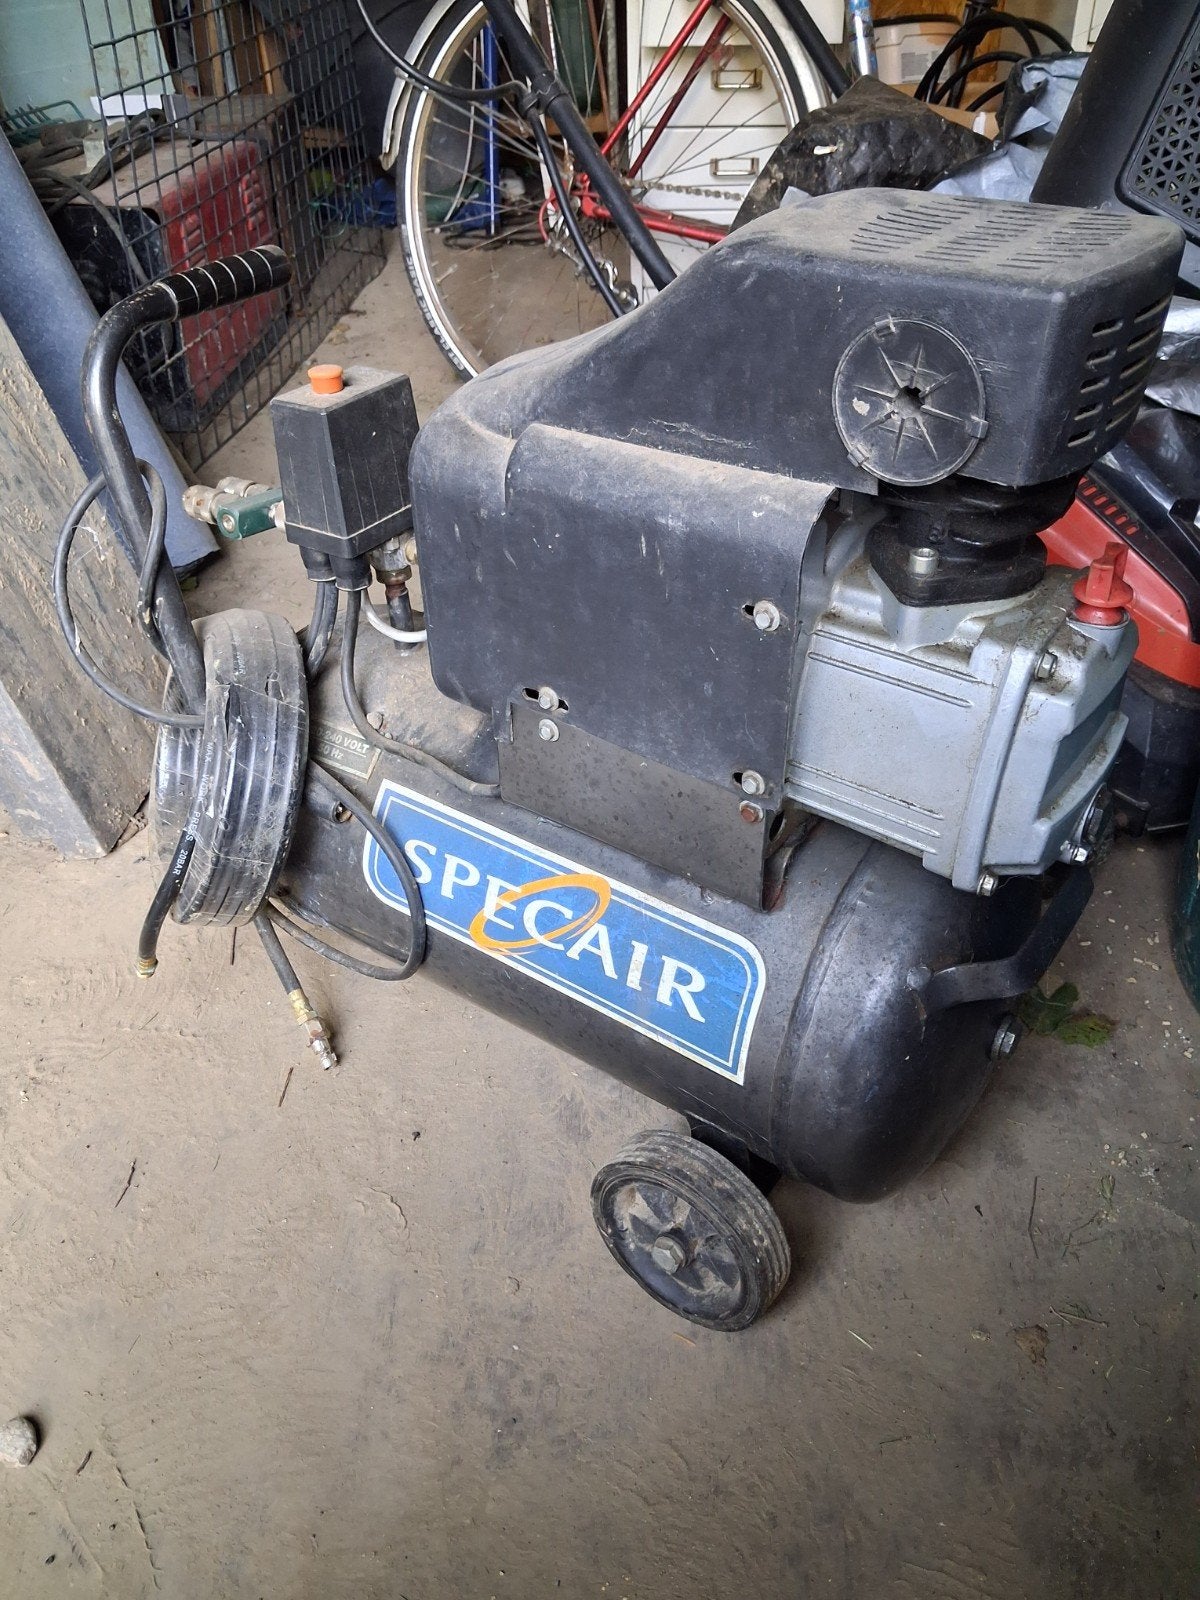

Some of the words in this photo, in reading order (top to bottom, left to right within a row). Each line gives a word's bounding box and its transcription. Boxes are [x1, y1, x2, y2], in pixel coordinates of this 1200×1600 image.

[330, 747, 344, 760] Hz
[343, 737, 370, 754] VOLT
[198, 774, 210, 804] WORK
[172, 848, 188, 876] 20BAR
[403, 838, 706, 1024] SPECAIR
